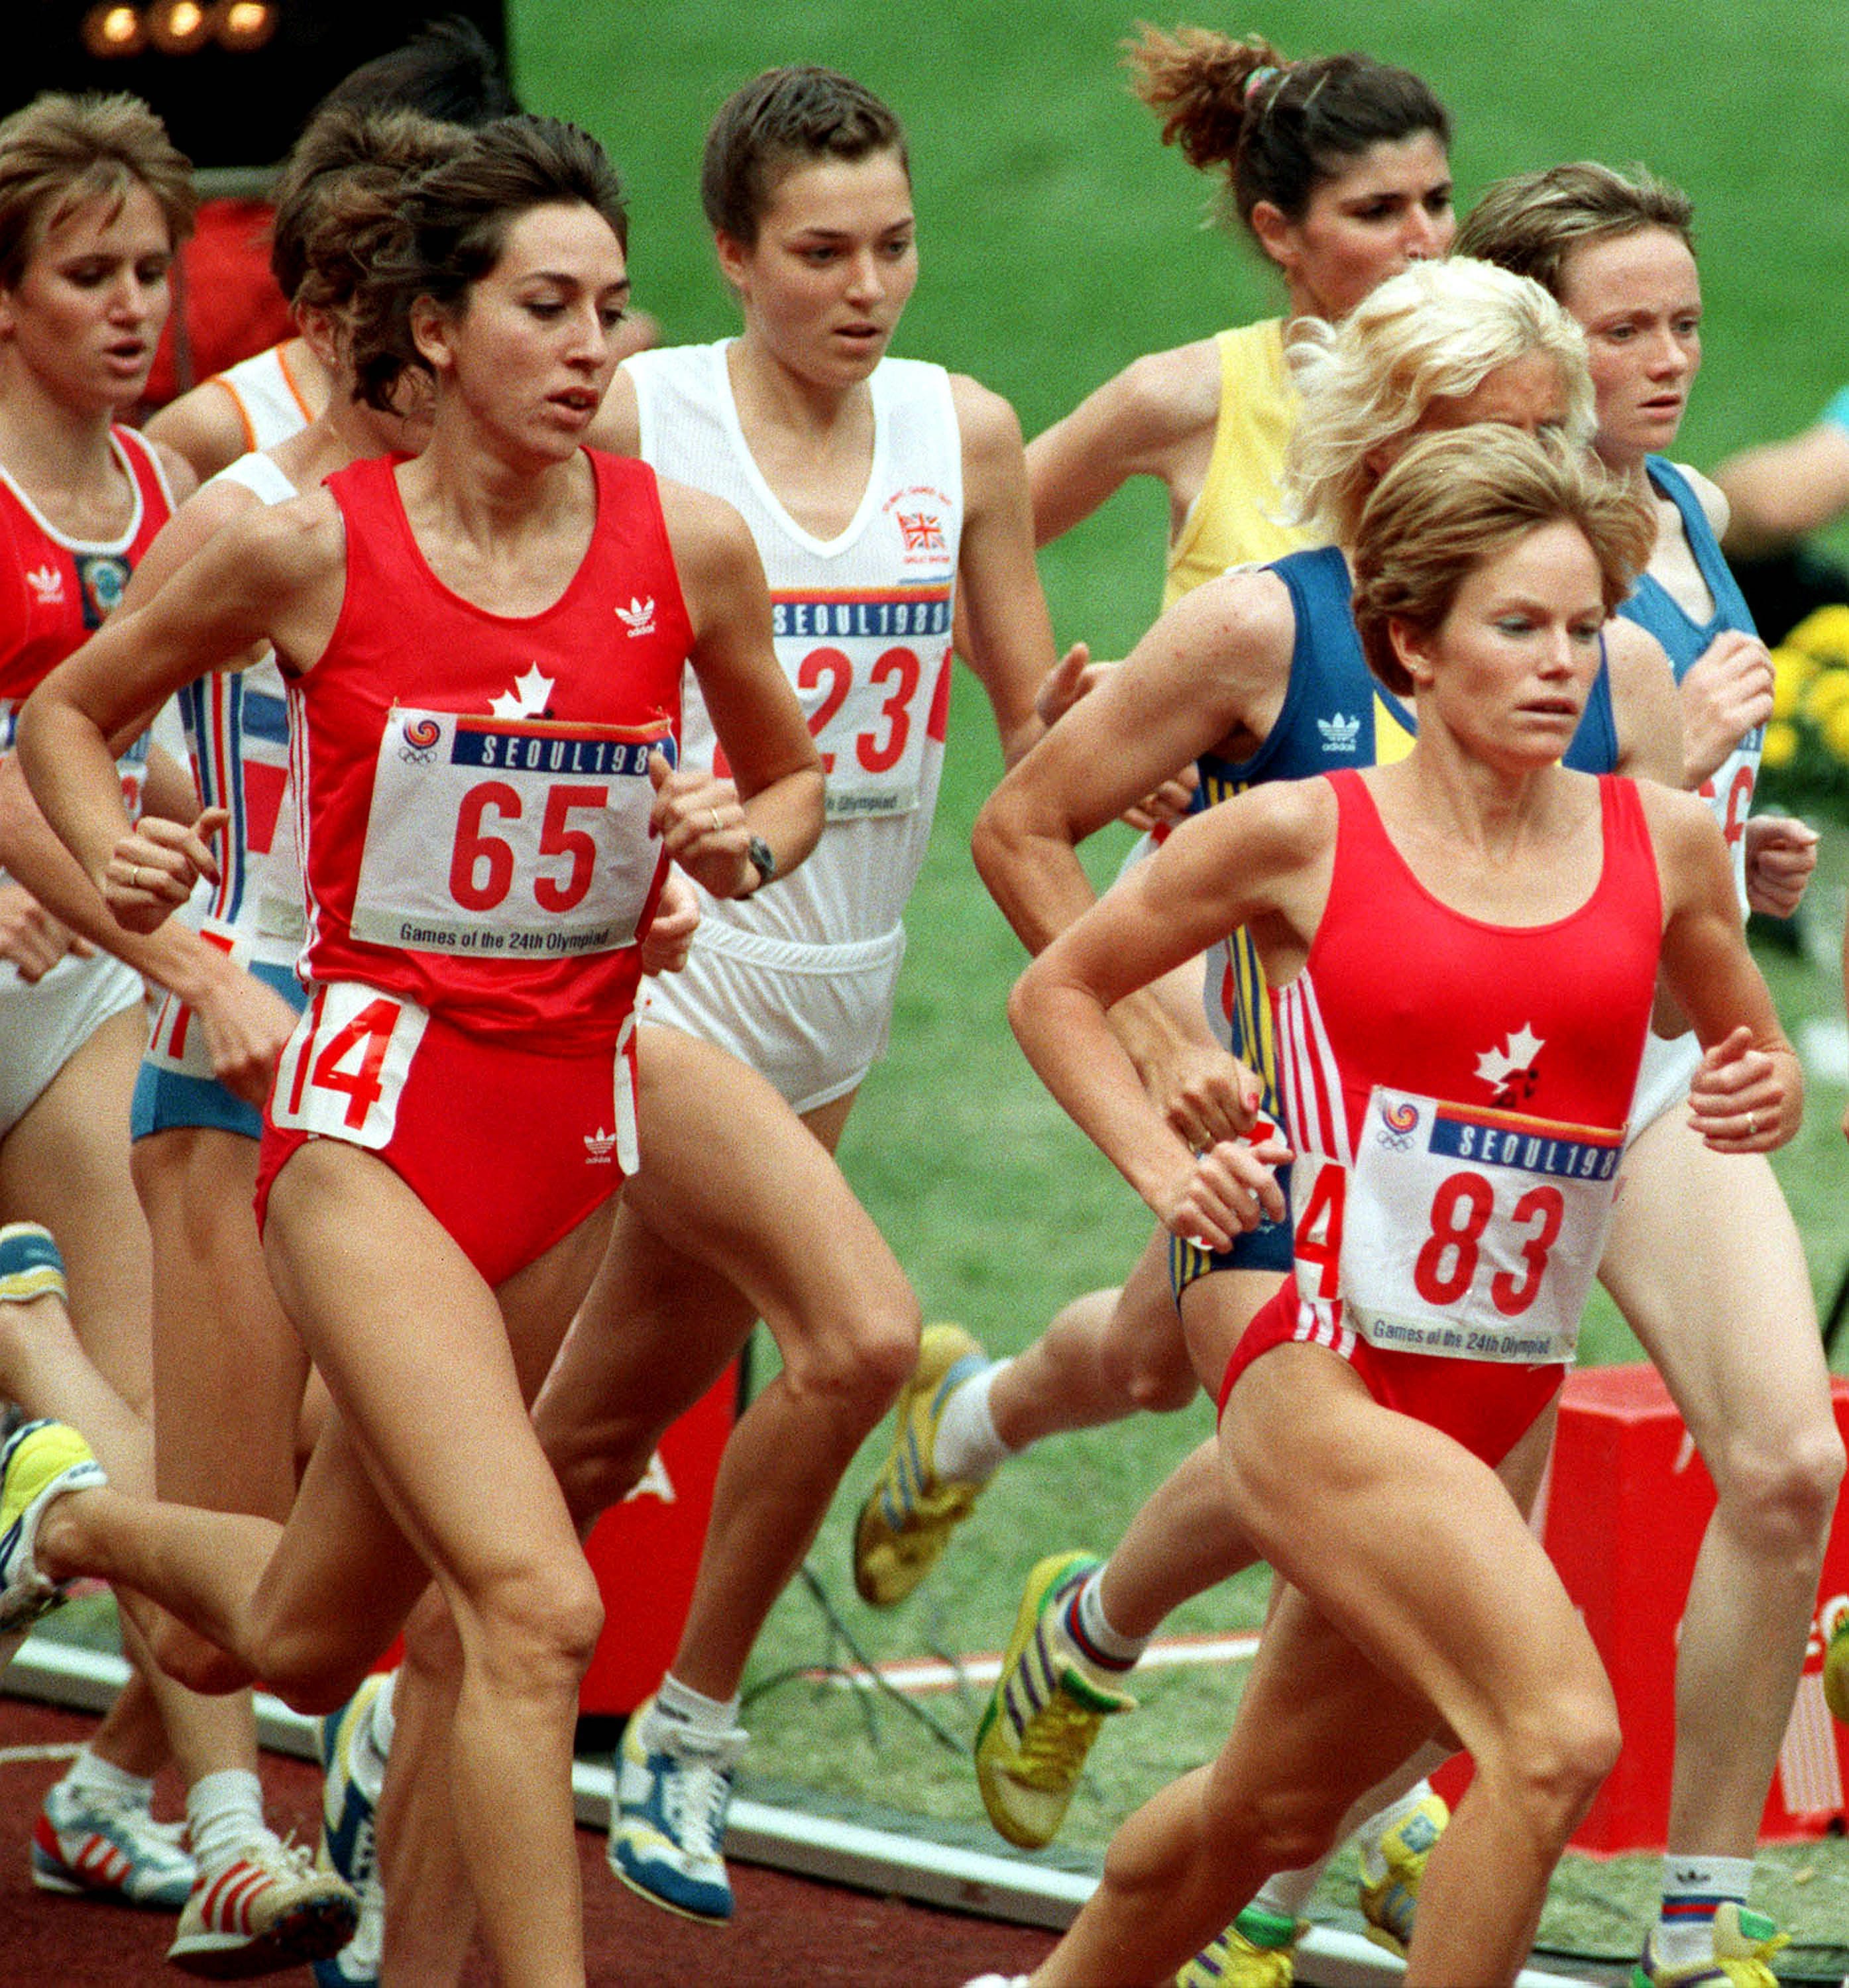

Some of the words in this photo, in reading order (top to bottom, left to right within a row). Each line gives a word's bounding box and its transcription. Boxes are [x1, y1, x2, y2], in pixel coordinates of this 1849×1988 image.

[712, 646, 920, 778] 23
[1321, 741, 1357, 752] adidas
[449, 781, 609, 912] 65
[400, 922, 455, 946] Games
[461, 929, 478, 948] of
[481, 932, 504, 949] the
[508, 932, 543, 950] 24th
[546, 929, 608, 952] Olympiad
[1414, 1171, 1565, 1316] 83
[1373, 1319, 1424, 1343] Games
[1427, 1327, 1441, 1345] of
[1443, 1329, 1462, 1347] the
[1465, 1332, 1497, 1353] 24th
[1501, 1336, 1551, 1356] Olympiad
